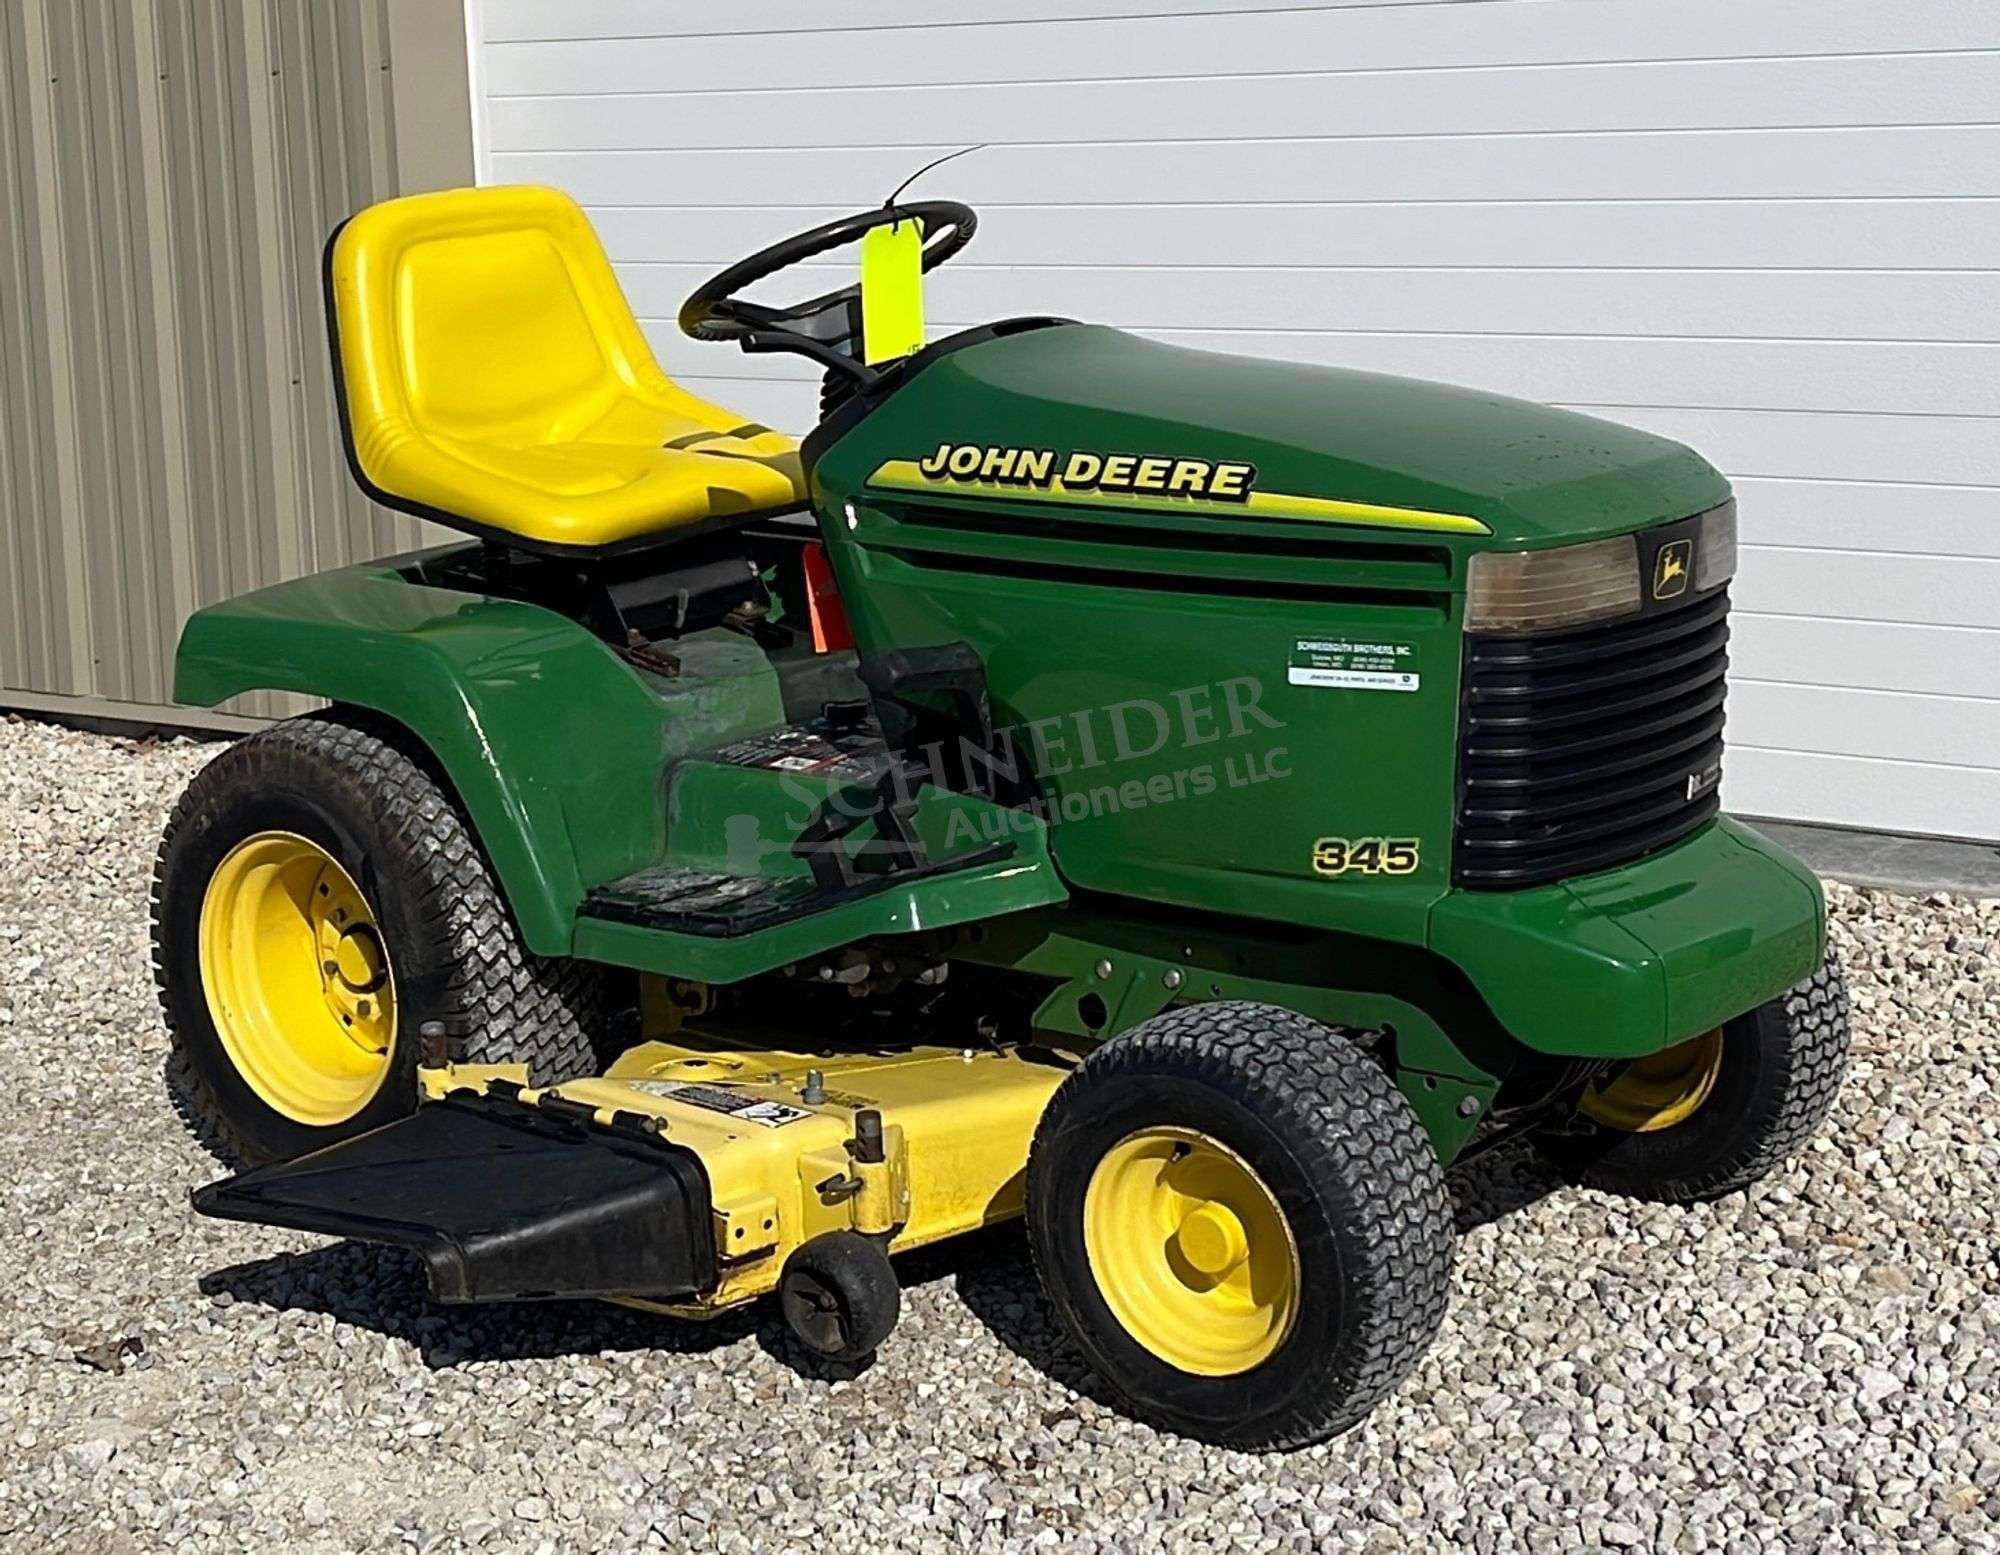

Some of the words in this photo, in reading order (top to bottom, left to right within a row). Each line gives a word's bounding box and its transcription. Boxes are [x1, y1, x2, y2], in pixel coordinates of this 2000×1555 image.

[920, 443, 1056, 486] JOHN
[1061, 450, 1253, 501] DEERE
[1314, 837, 1420, 874] 345
